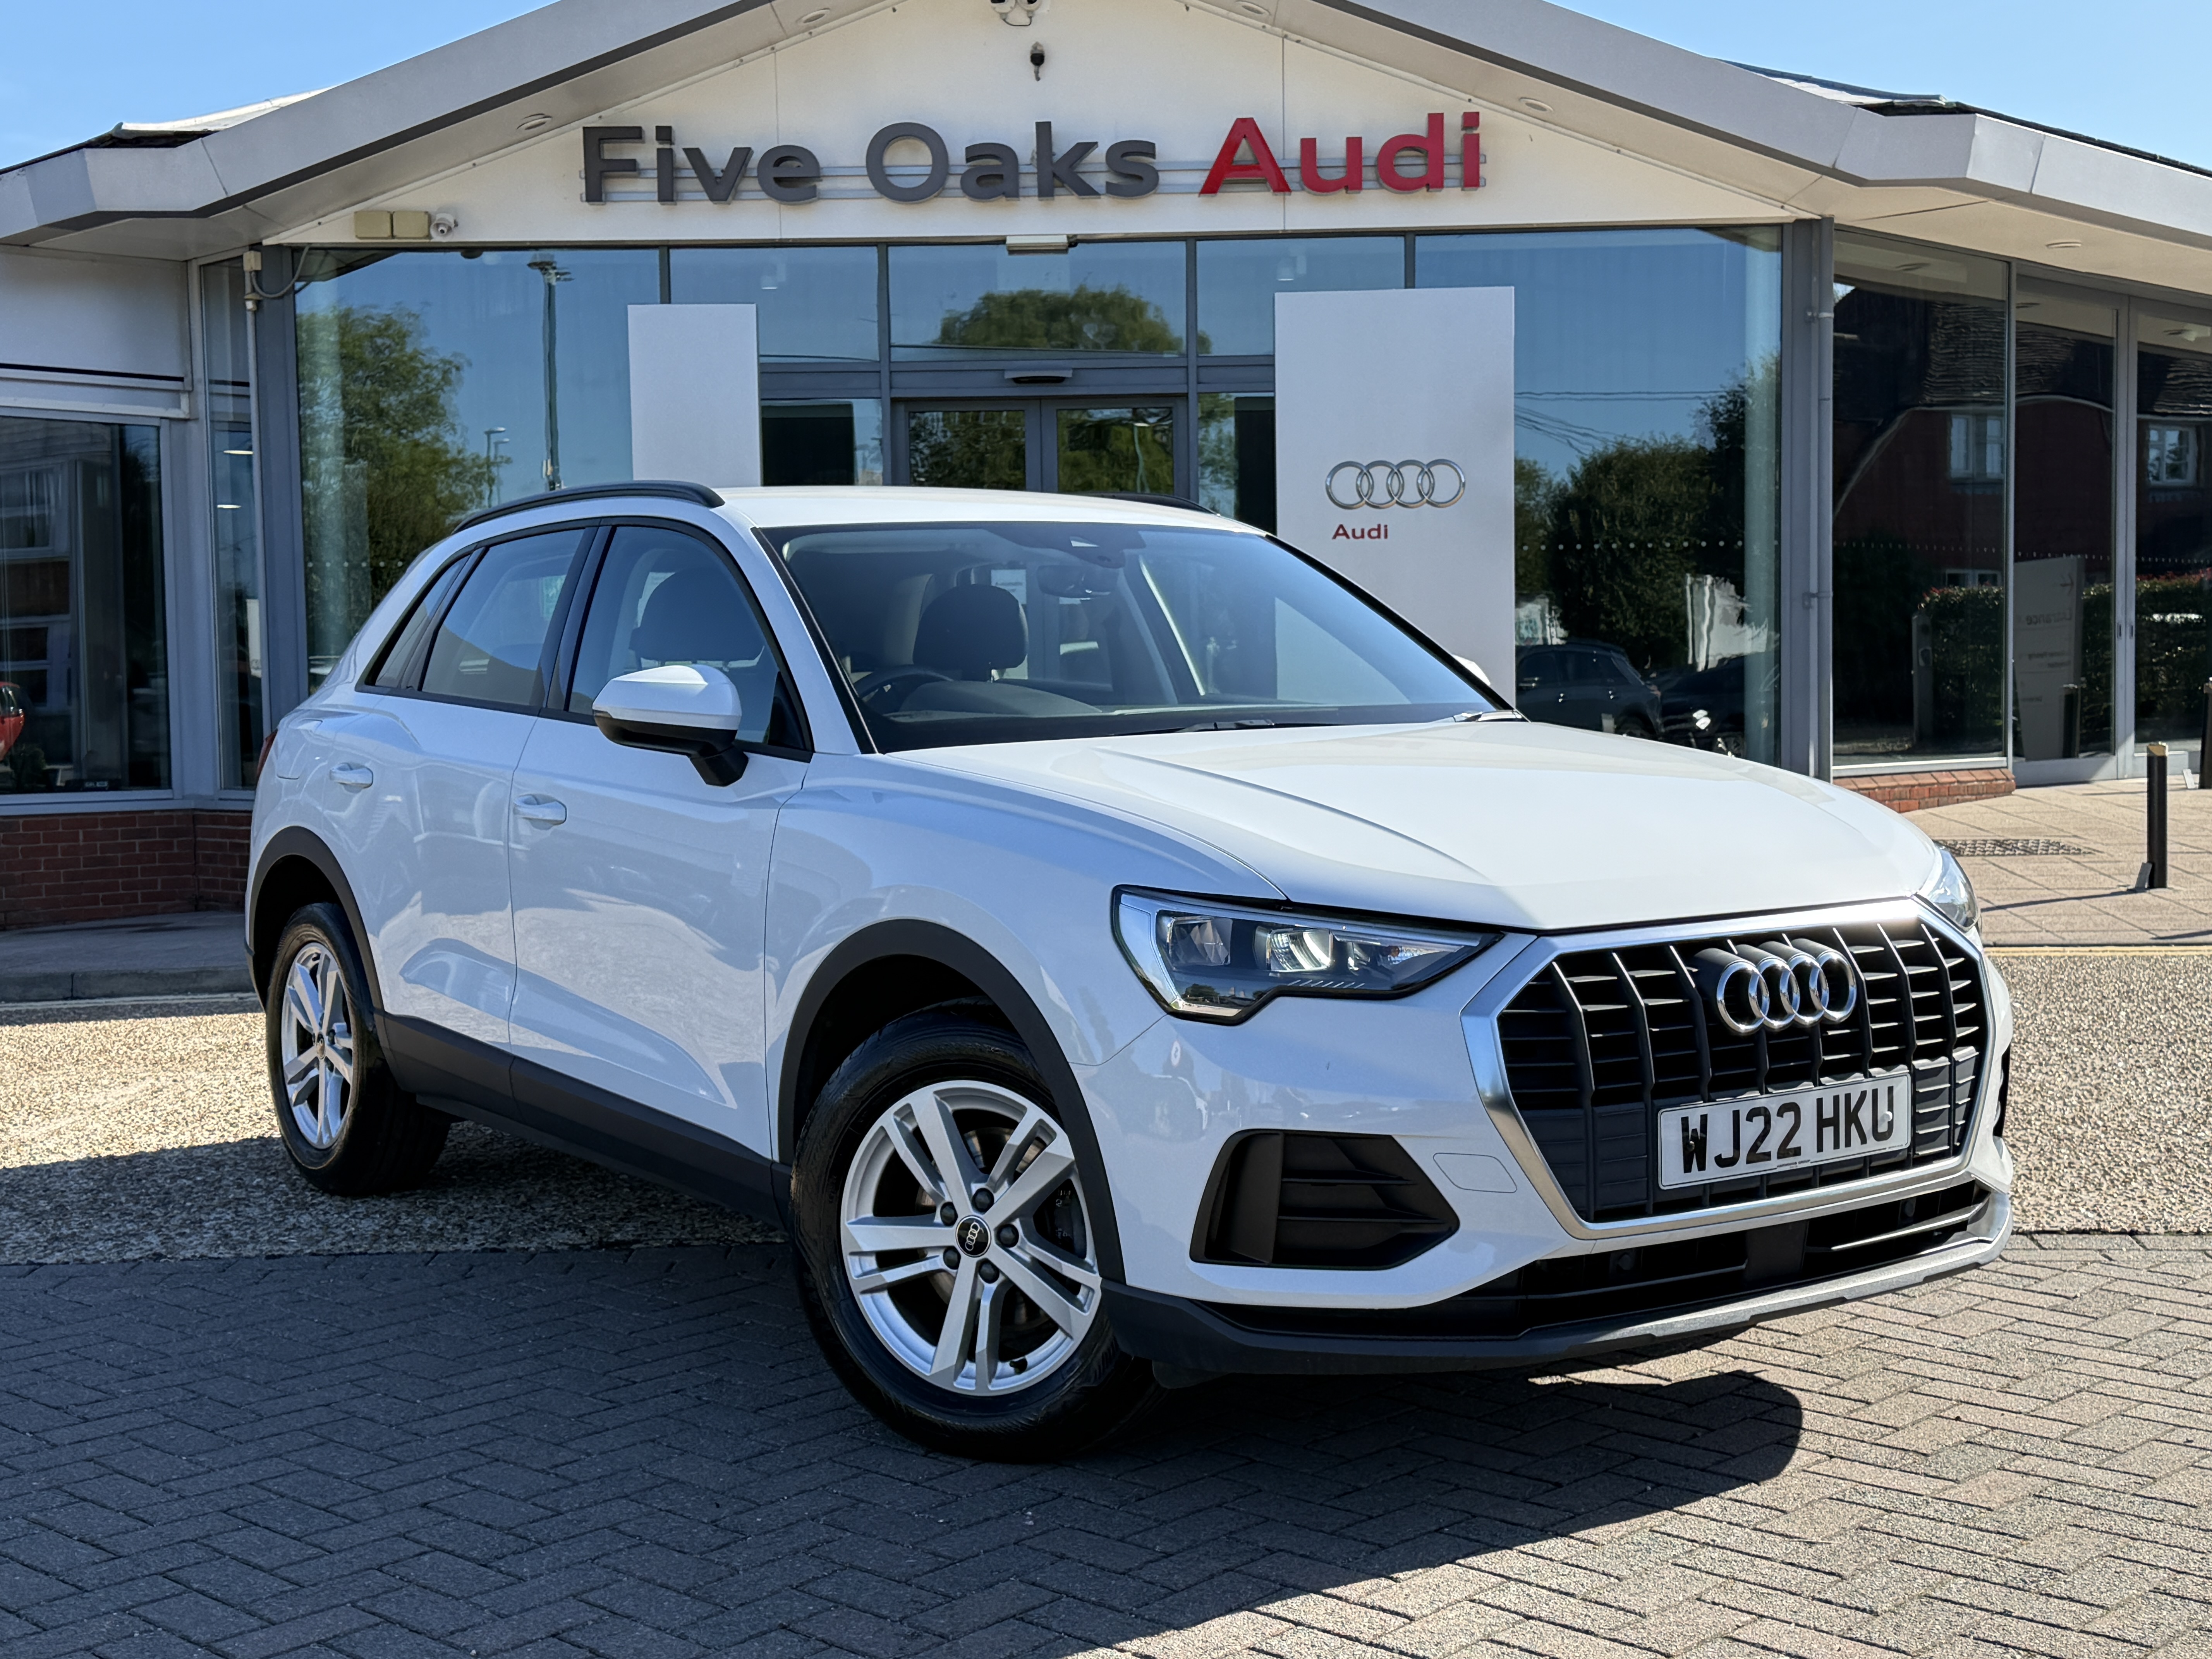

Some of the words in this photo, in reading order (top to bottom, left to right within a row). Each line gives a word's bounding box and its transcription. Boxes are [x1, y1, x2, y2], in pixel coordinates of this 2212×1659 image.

[583, 125, 822, 205] Five
[865, 121, 1159, 203] Oaks
[1200, 112, 1480, 197] Audi
[1332, 524, 1388, 539] Audi
[1680, 1102, 1802, 1173] WJ22
[1816, 1086, 1894, 1153] HKU
